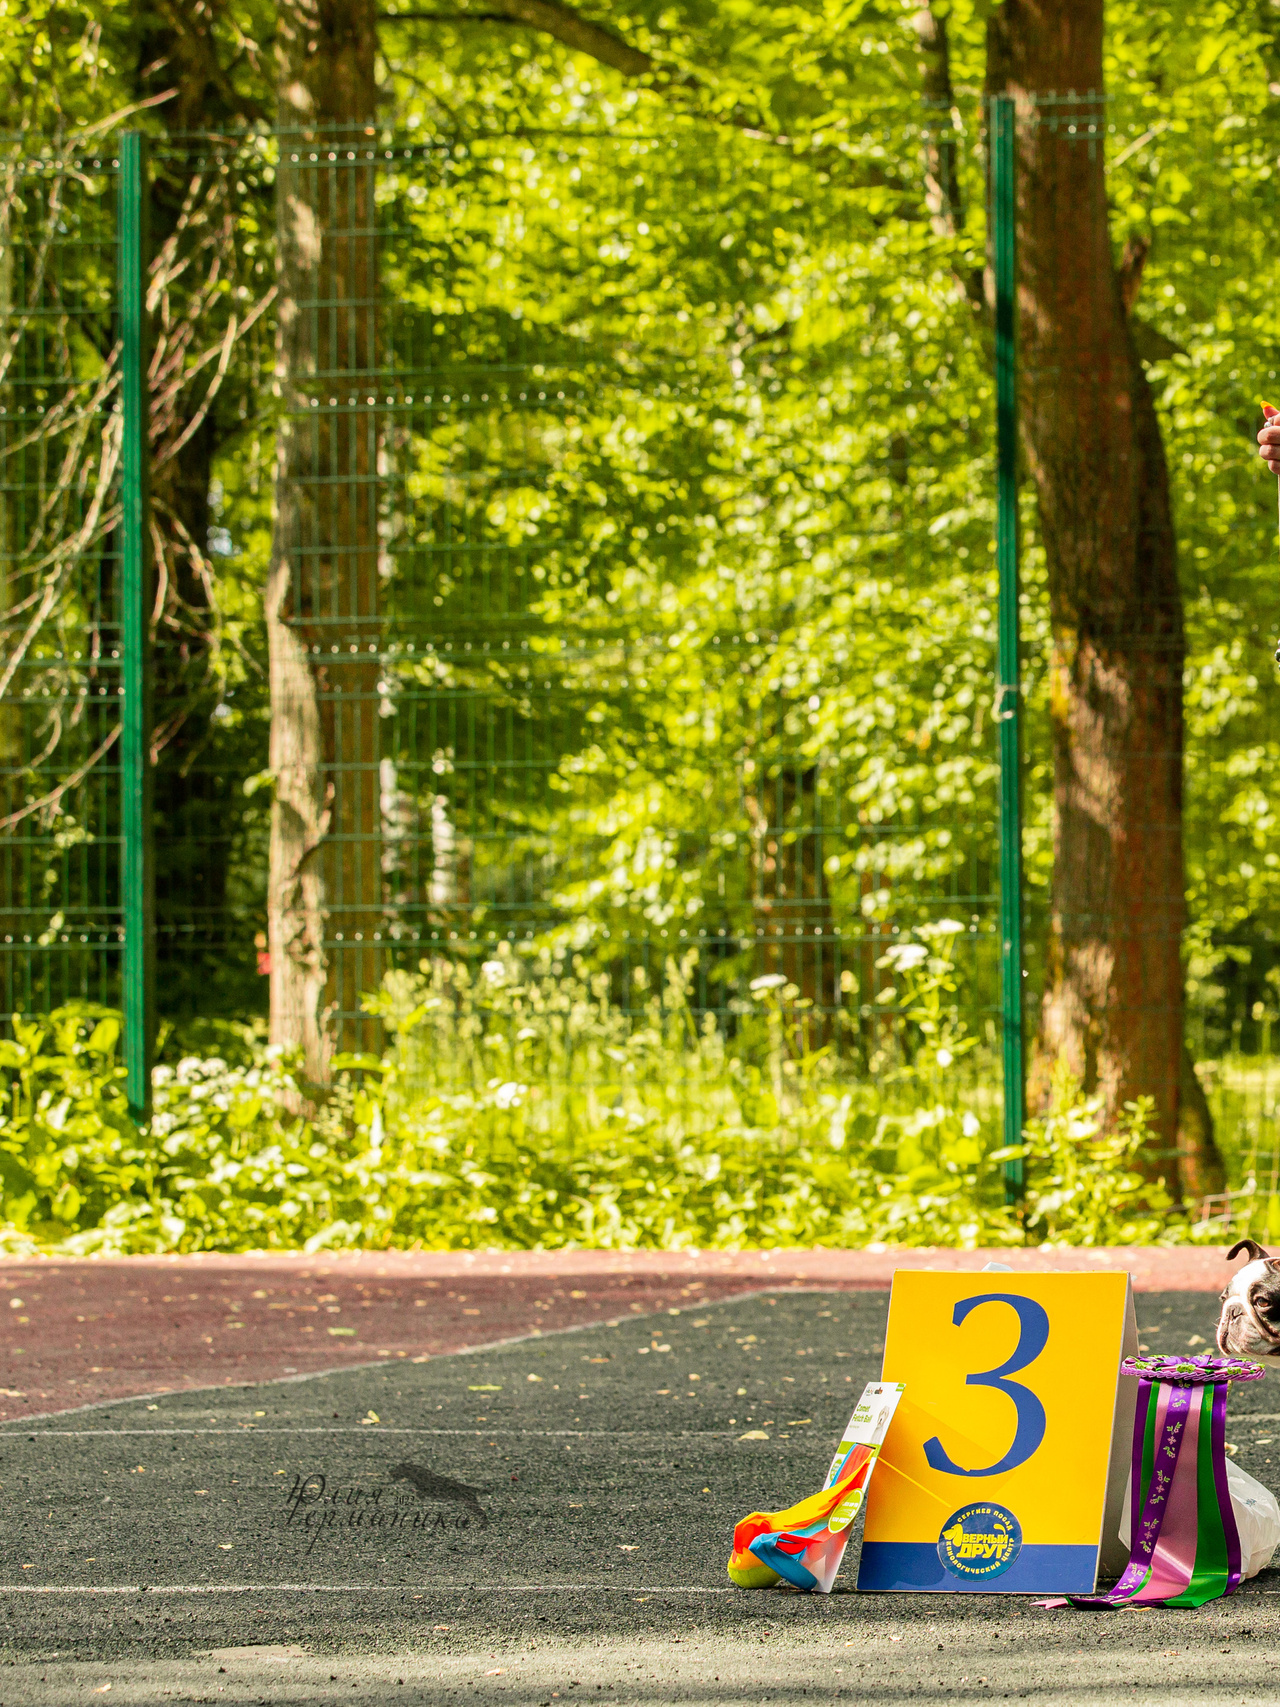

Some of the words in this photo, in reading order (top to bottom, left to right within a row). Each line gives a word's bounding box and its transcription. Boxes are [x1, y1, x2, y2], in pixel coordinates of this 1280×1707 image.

[922, 1293, 1050, 1477] 3
[957, 1508, 991, 1523] СЕРГИЕВ
[993, 1510, 1014, 1531] ПОСАД
[962, 1533, 1009, 1544] ВЕРНЫЙ
[945, 1541, 1001, 1574] КИНОЛОГИЧЕСКИЙ
[1001, 1537, 1015, 1562] ЦЕНТР
[956, 1543, 1008, 1559] ДРУГ
